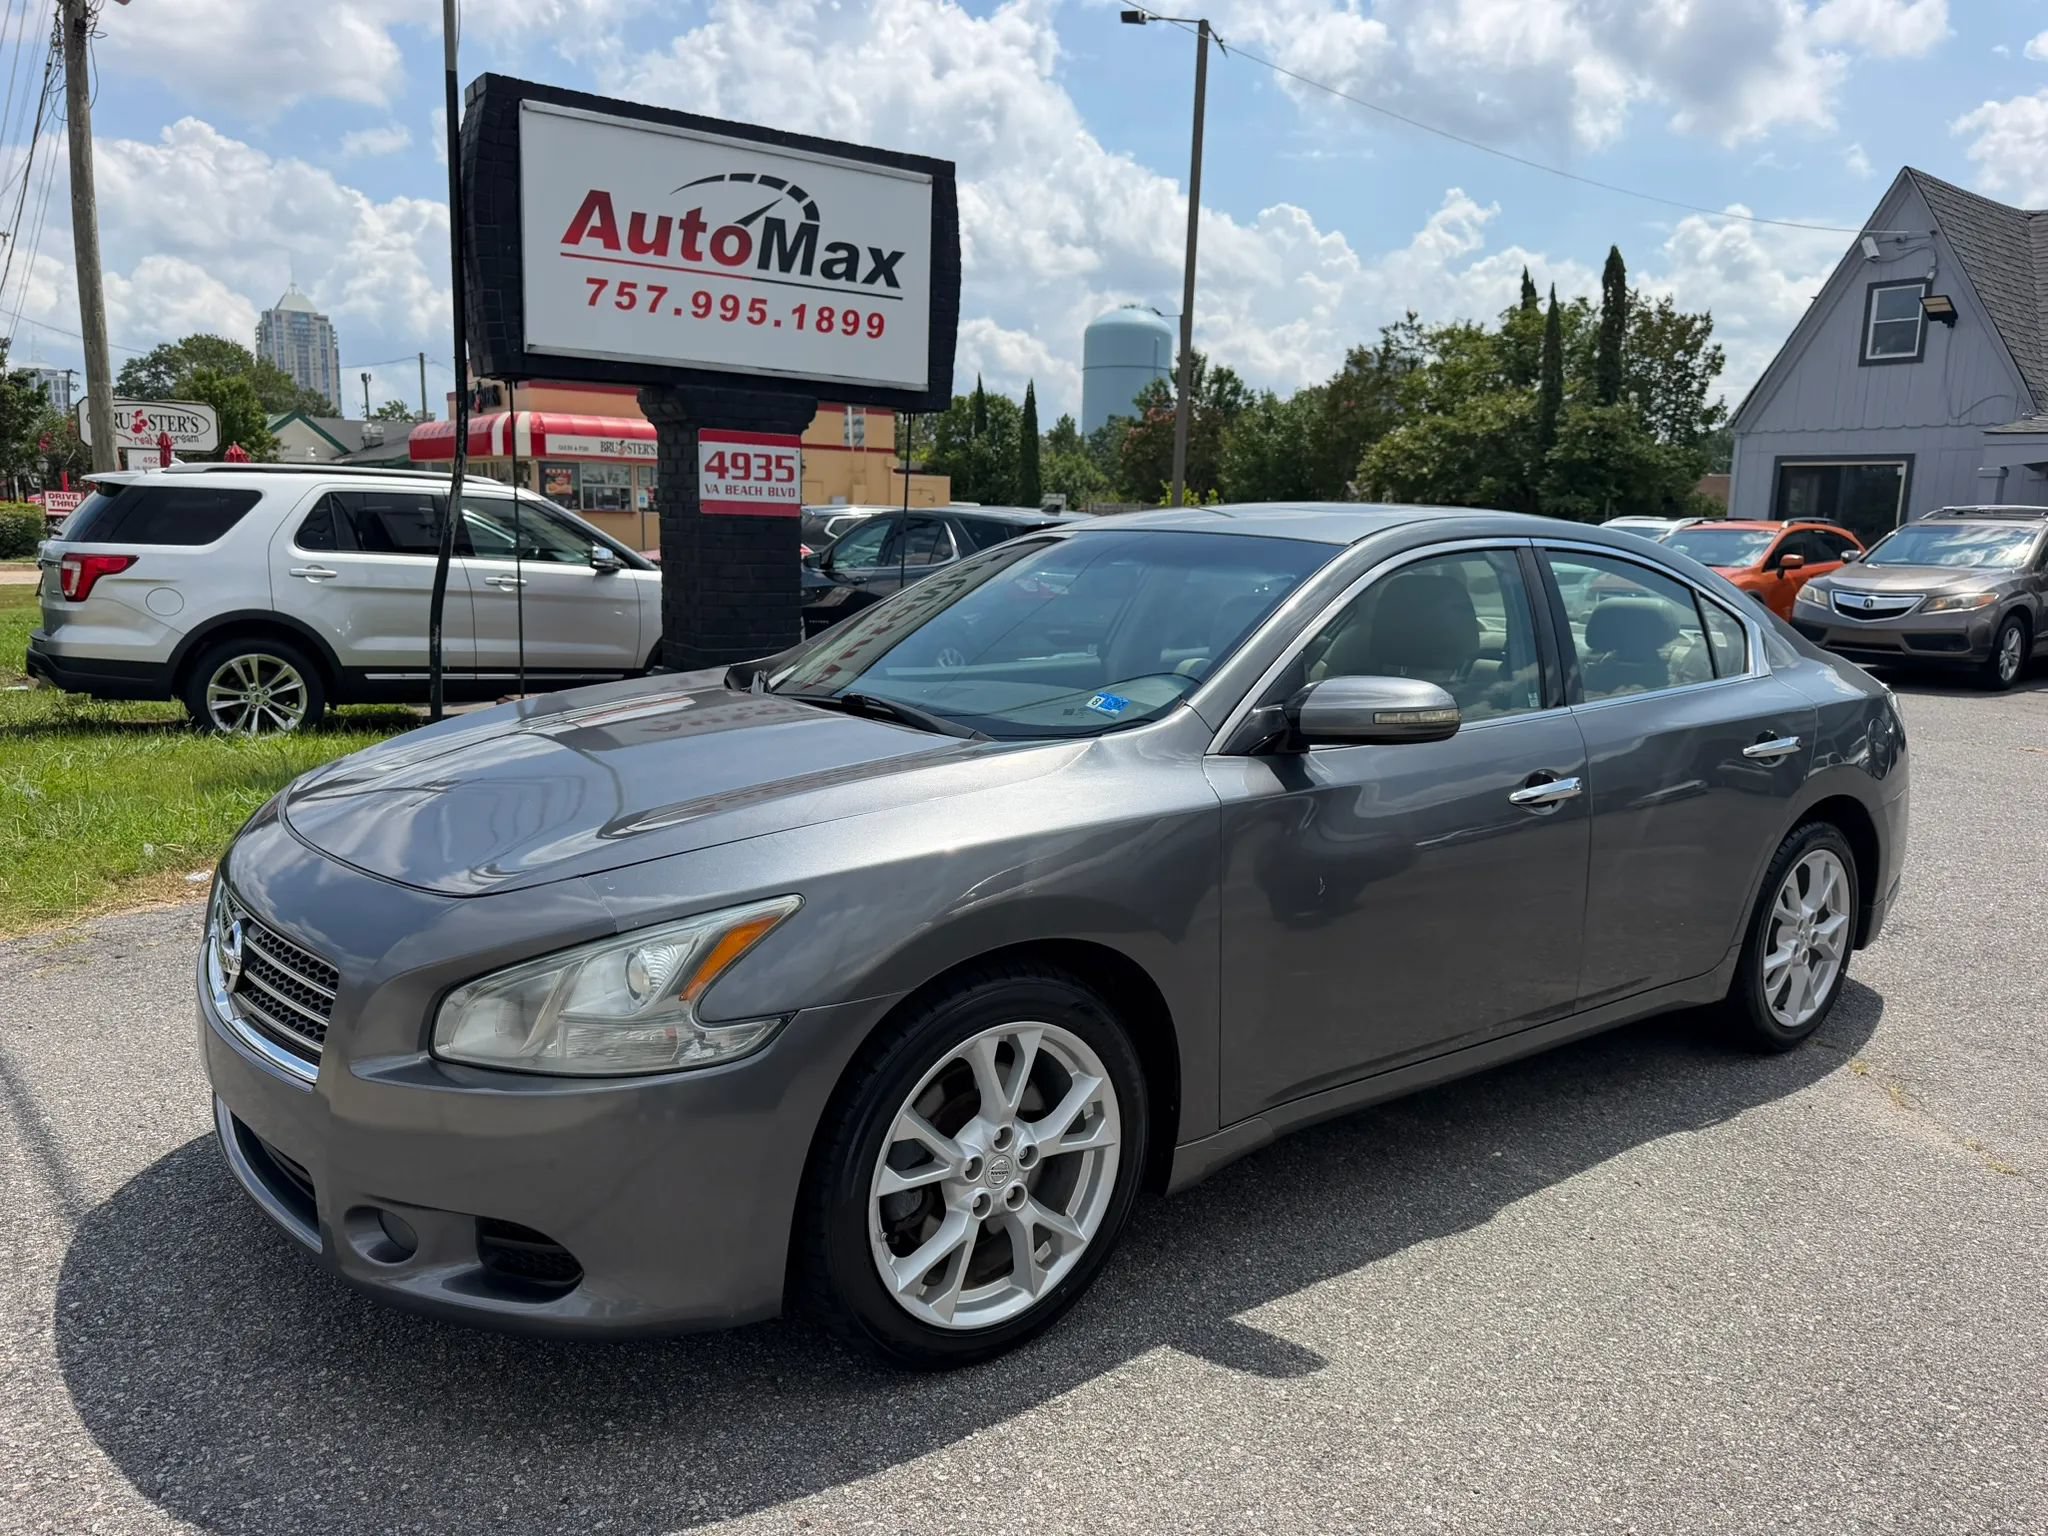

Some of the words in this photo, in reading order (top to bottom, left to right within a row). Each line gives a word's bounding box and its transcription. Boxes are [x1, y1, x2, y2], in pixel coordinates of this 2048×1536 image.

[560, 189, 906, 289] AutoMax
[586, 277, 886, 339] 757.995.1899
[704, 450, 795, 483] 4935
[48, 492, 79, 501] DRIVE
[704, 483, 720, 494] VA
[725, 484, 763, 497] BEACH
[767, 486, 796, 498] BLVD
[50, 500, 78, 508] THRU
